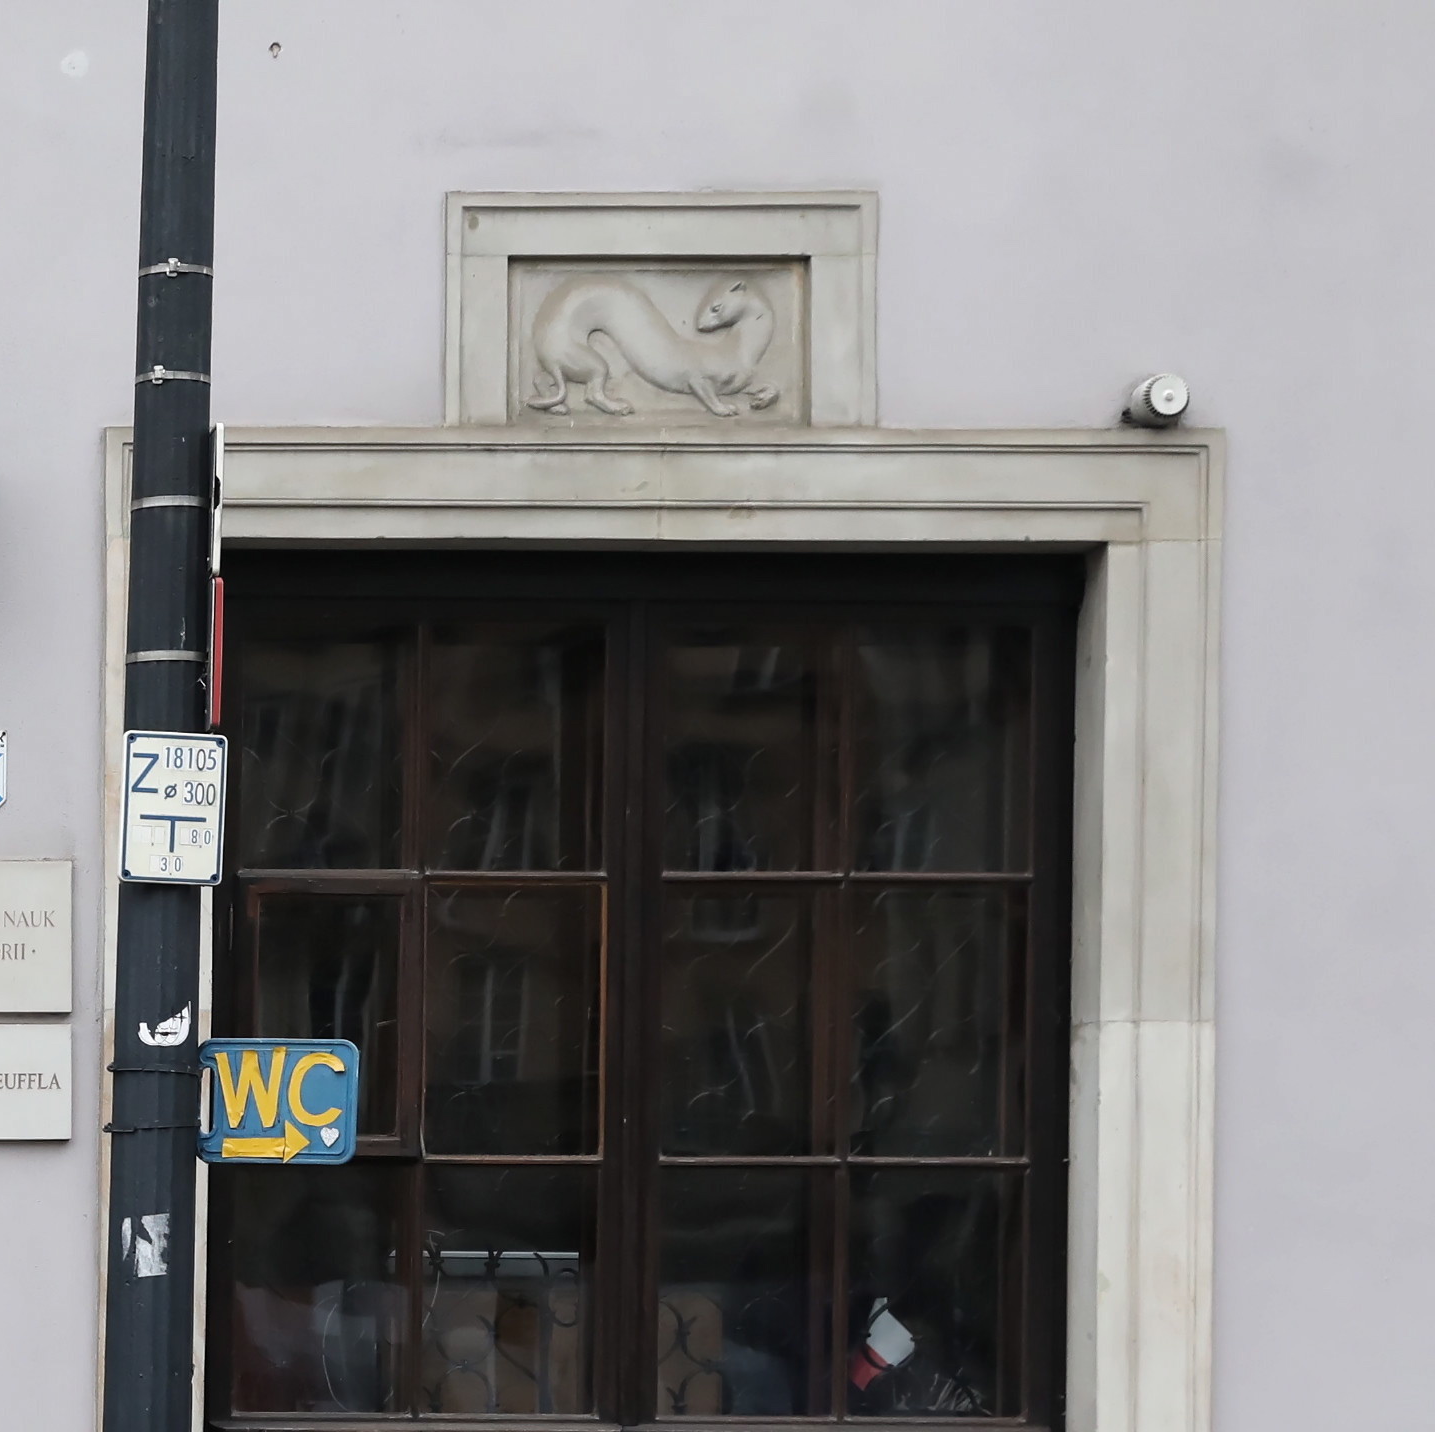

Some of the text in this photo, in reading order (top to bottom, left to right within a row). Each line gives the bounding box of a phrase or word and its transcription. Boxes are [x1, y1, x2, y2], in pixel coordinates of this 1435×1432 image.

[131, 746, 217, 793] Z 18105
[184, 781, 216, 805] 300
[3, 910, 56, 928] NAUK
[215, 1046, 346, 1128] WC
